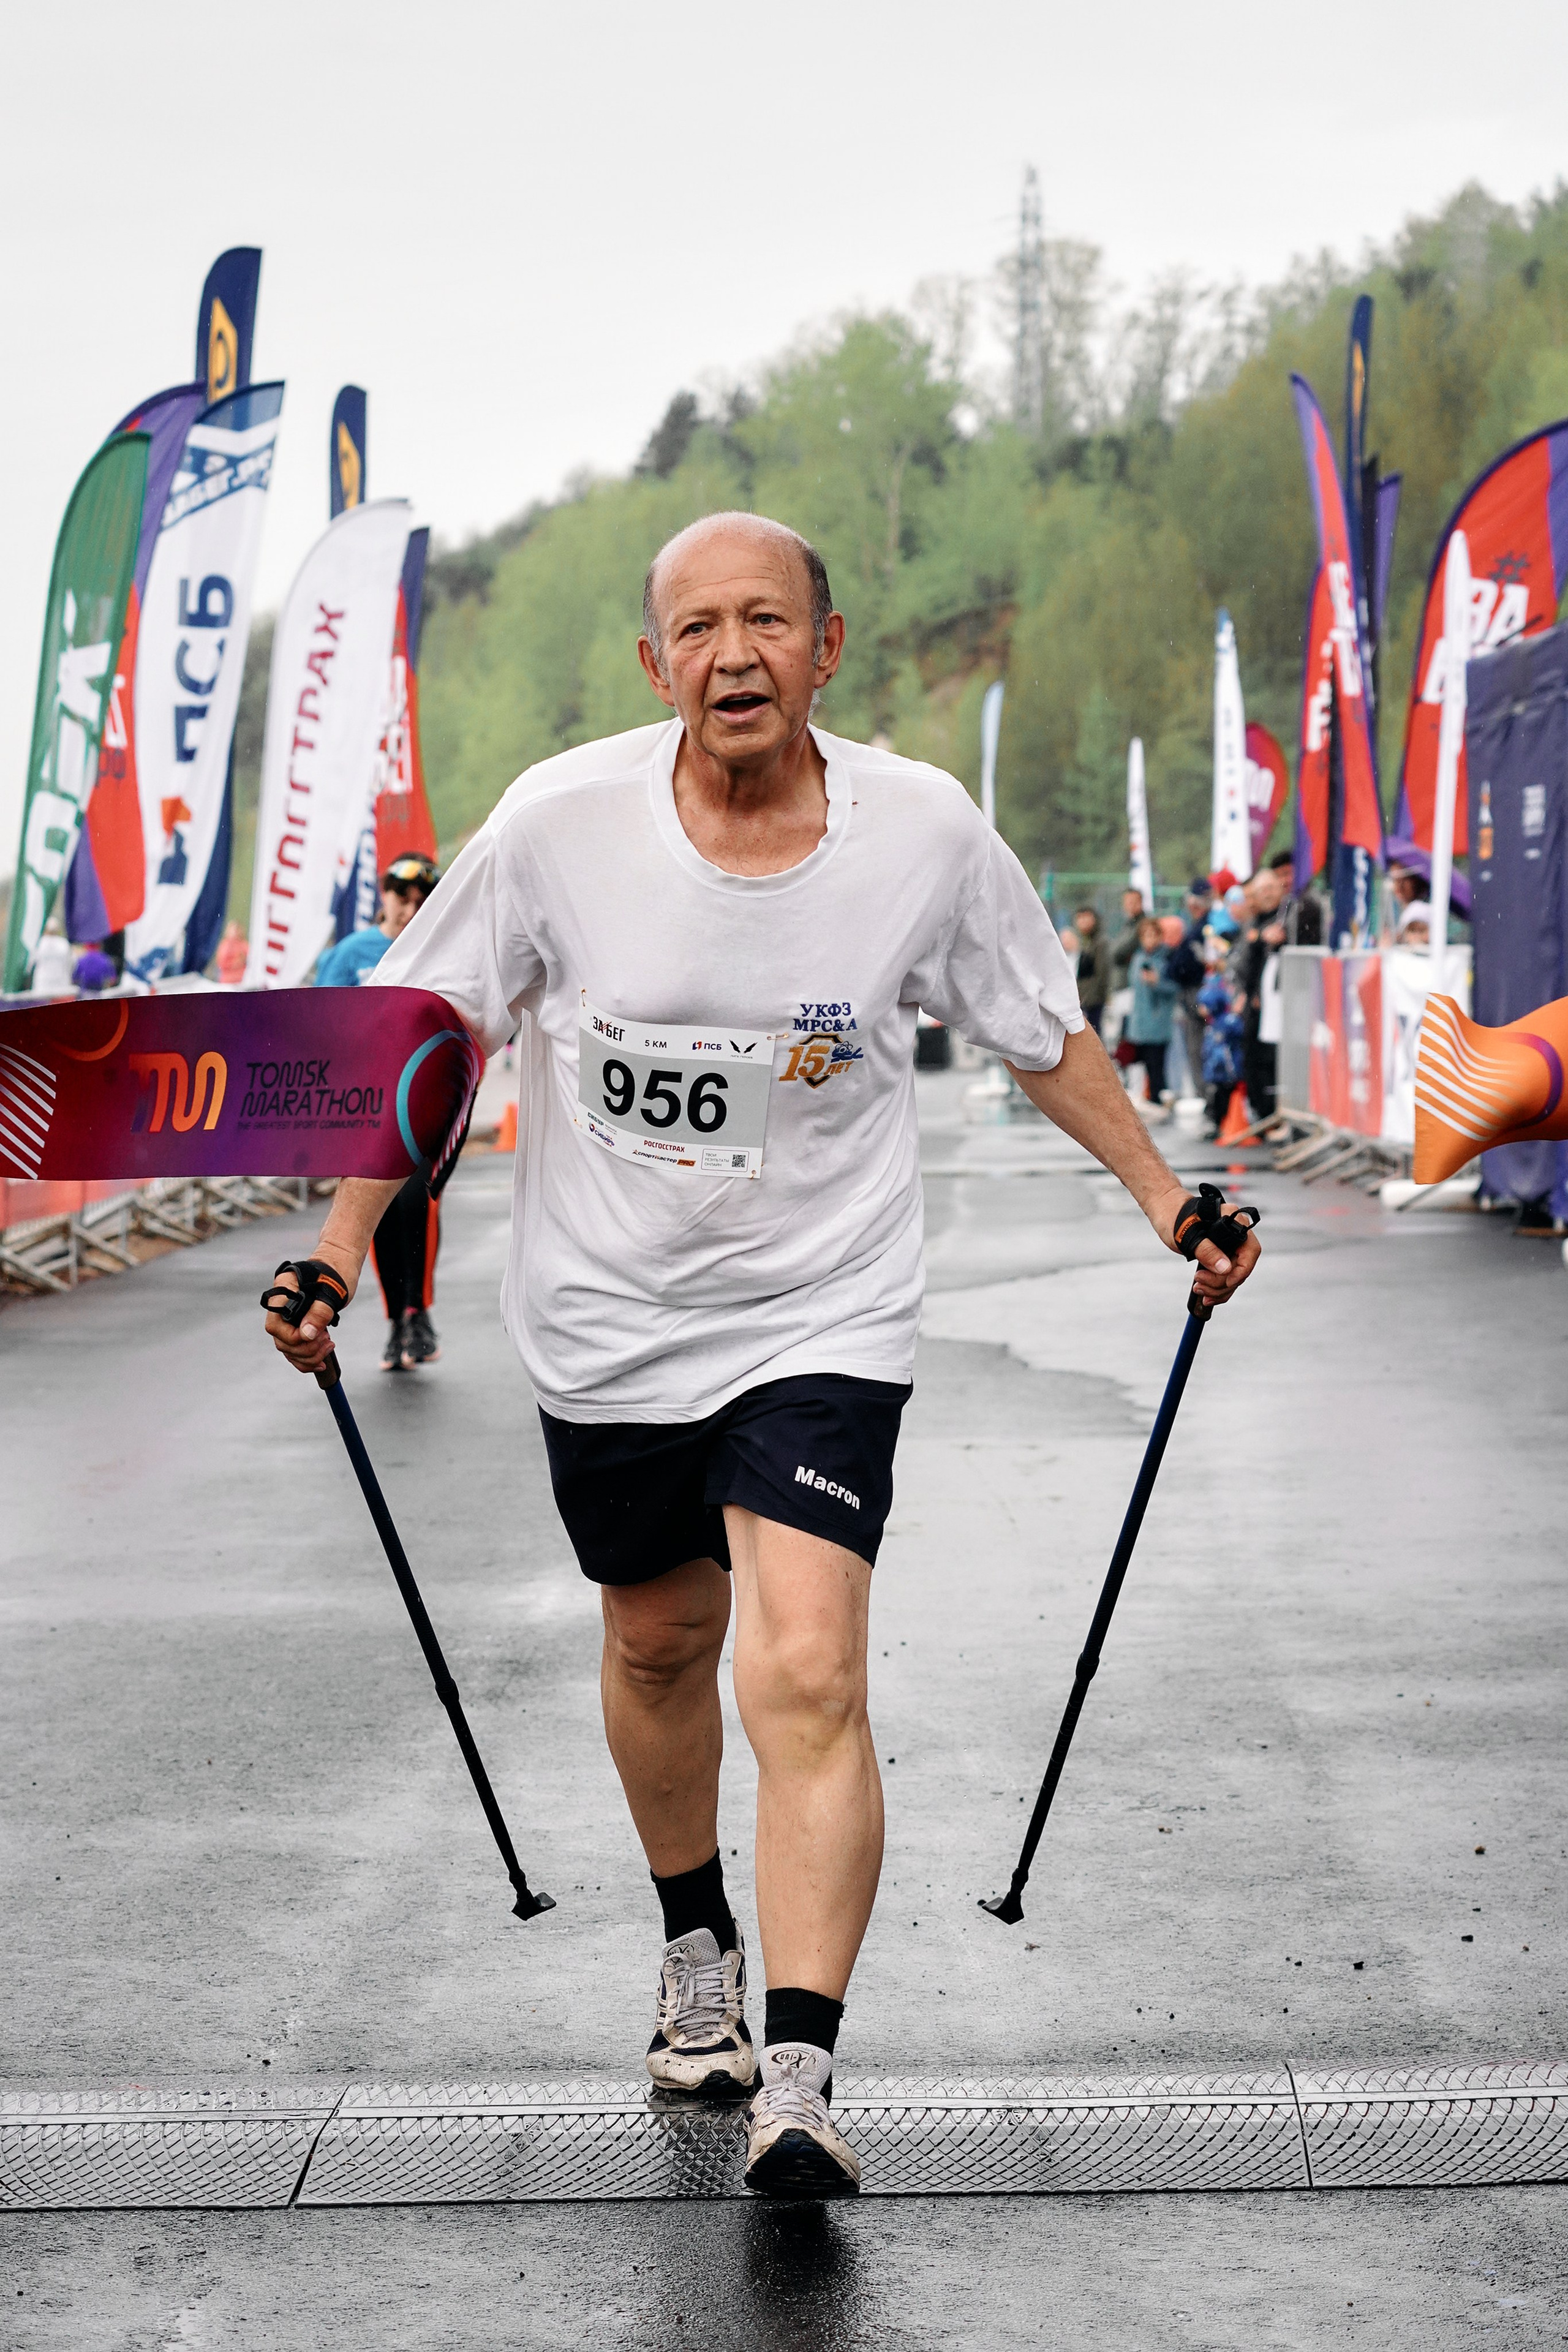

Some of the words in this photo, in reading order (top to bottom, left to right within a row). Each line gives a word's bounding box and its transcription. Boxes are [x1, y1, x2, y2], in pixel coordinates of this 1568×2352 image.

[800, 1003, 851, 1017] УКФЗ
[247, 1059, 330, 1090] TOMSK
[778, 1046, 830, 1081] 15
[240, 1087, 383, 1117] MARATHON
[603, 1059, 729, 1133] 956
[644, 1140, 685, 1153] РОСГОССТРАХ
[794, 1465, 860, 1510] Macron
